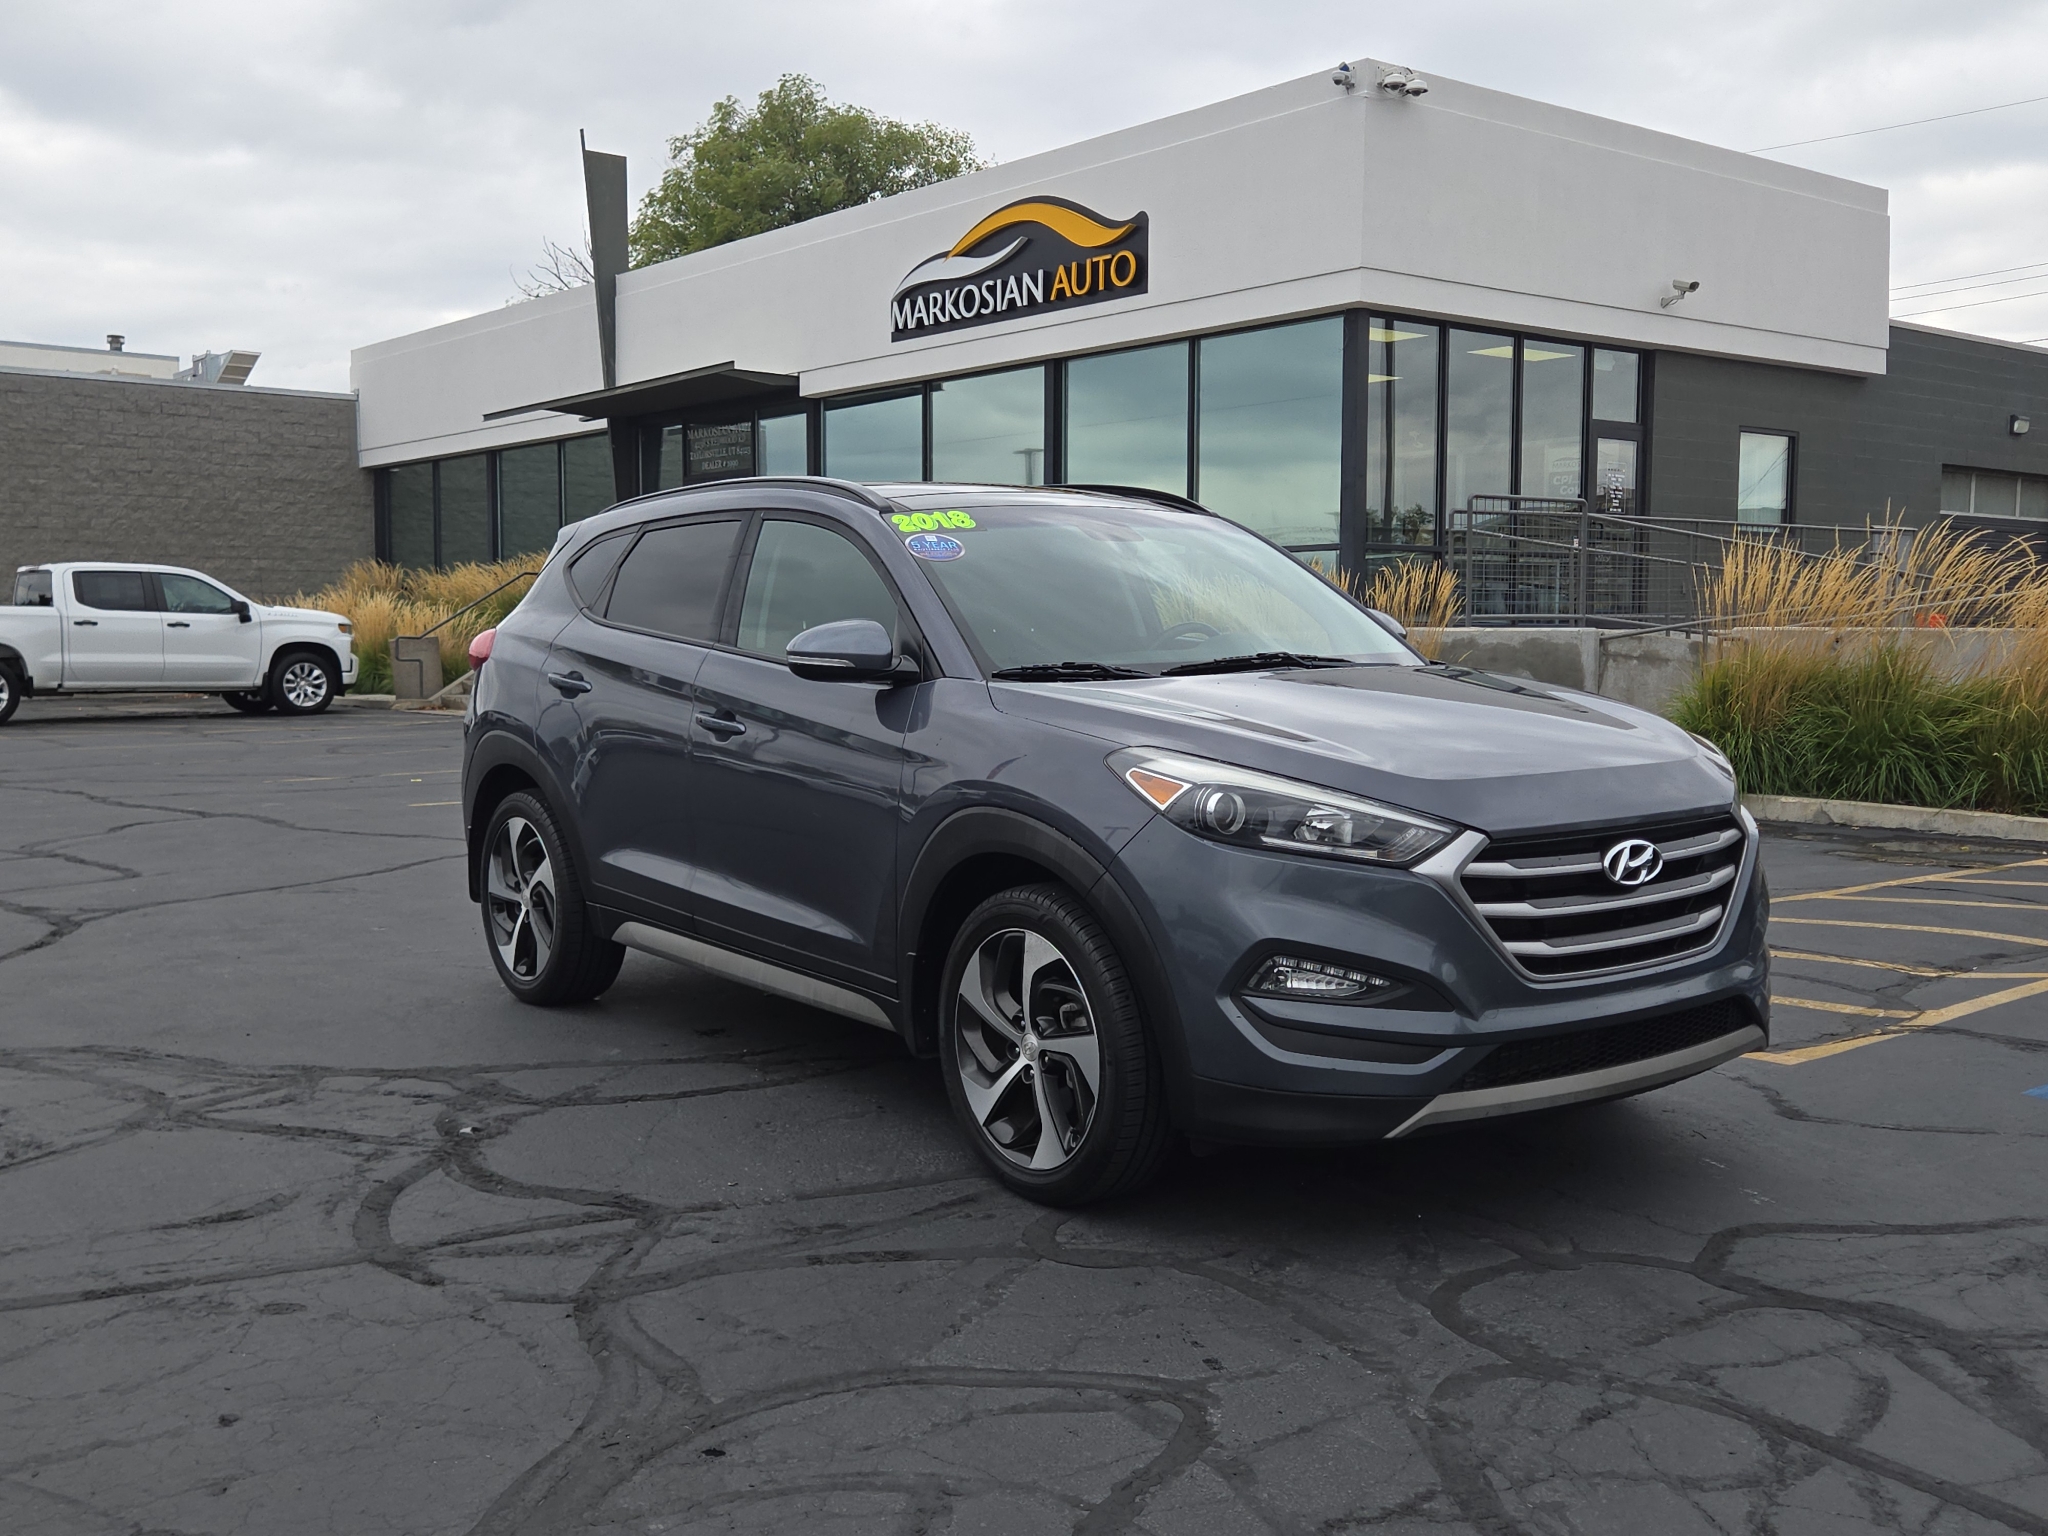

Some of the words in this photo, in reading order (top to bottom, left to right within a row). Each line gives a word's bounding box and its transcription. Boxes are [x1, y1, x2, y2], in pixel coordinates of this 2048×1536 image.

[890, 269, 1044, 332] MARKOSIAN
[1050, 249, 1137, 301] AUTO
[891, 510, 976, 532] 2018
[910, 541, 920, 549] 5
[921, 541, 958, 549] YEAR
